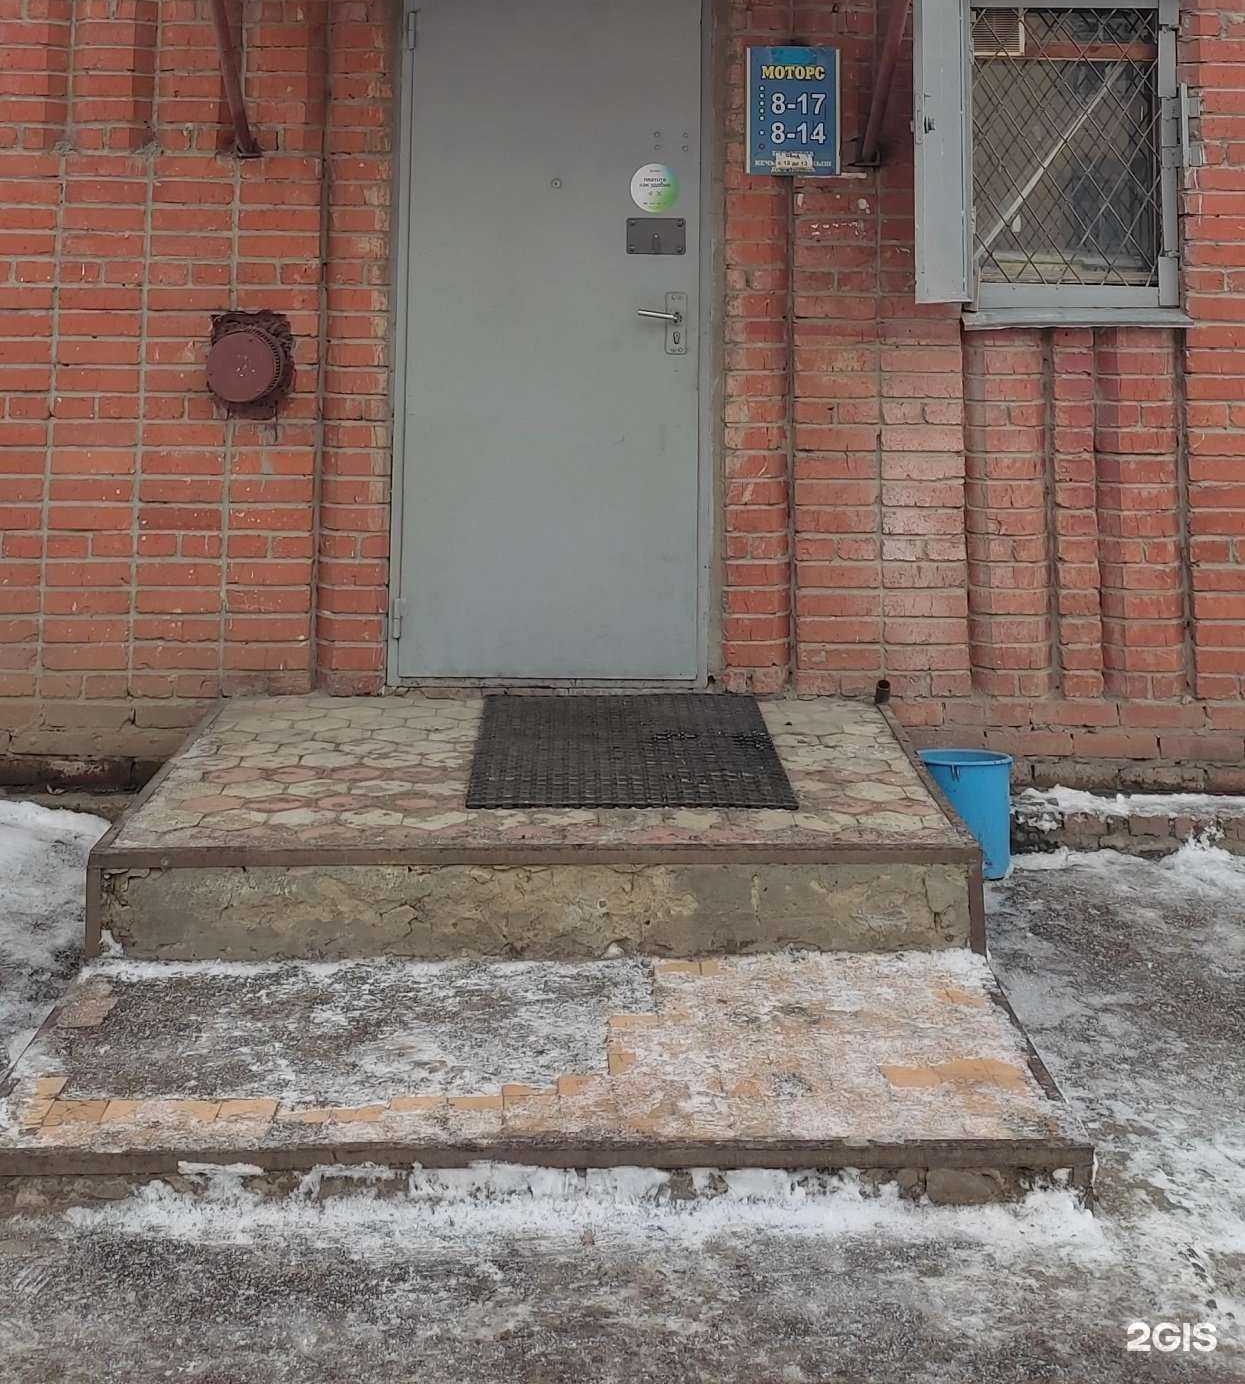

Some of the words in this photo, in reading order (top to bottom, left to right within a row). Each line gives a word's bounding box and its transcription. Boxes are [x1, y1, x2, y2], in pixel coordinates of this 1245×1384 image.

[761, 65, 826, 81] МОТОРС
[770, 92, 826, 115] 8-17
[770, 122, 826, 144] 8-14
